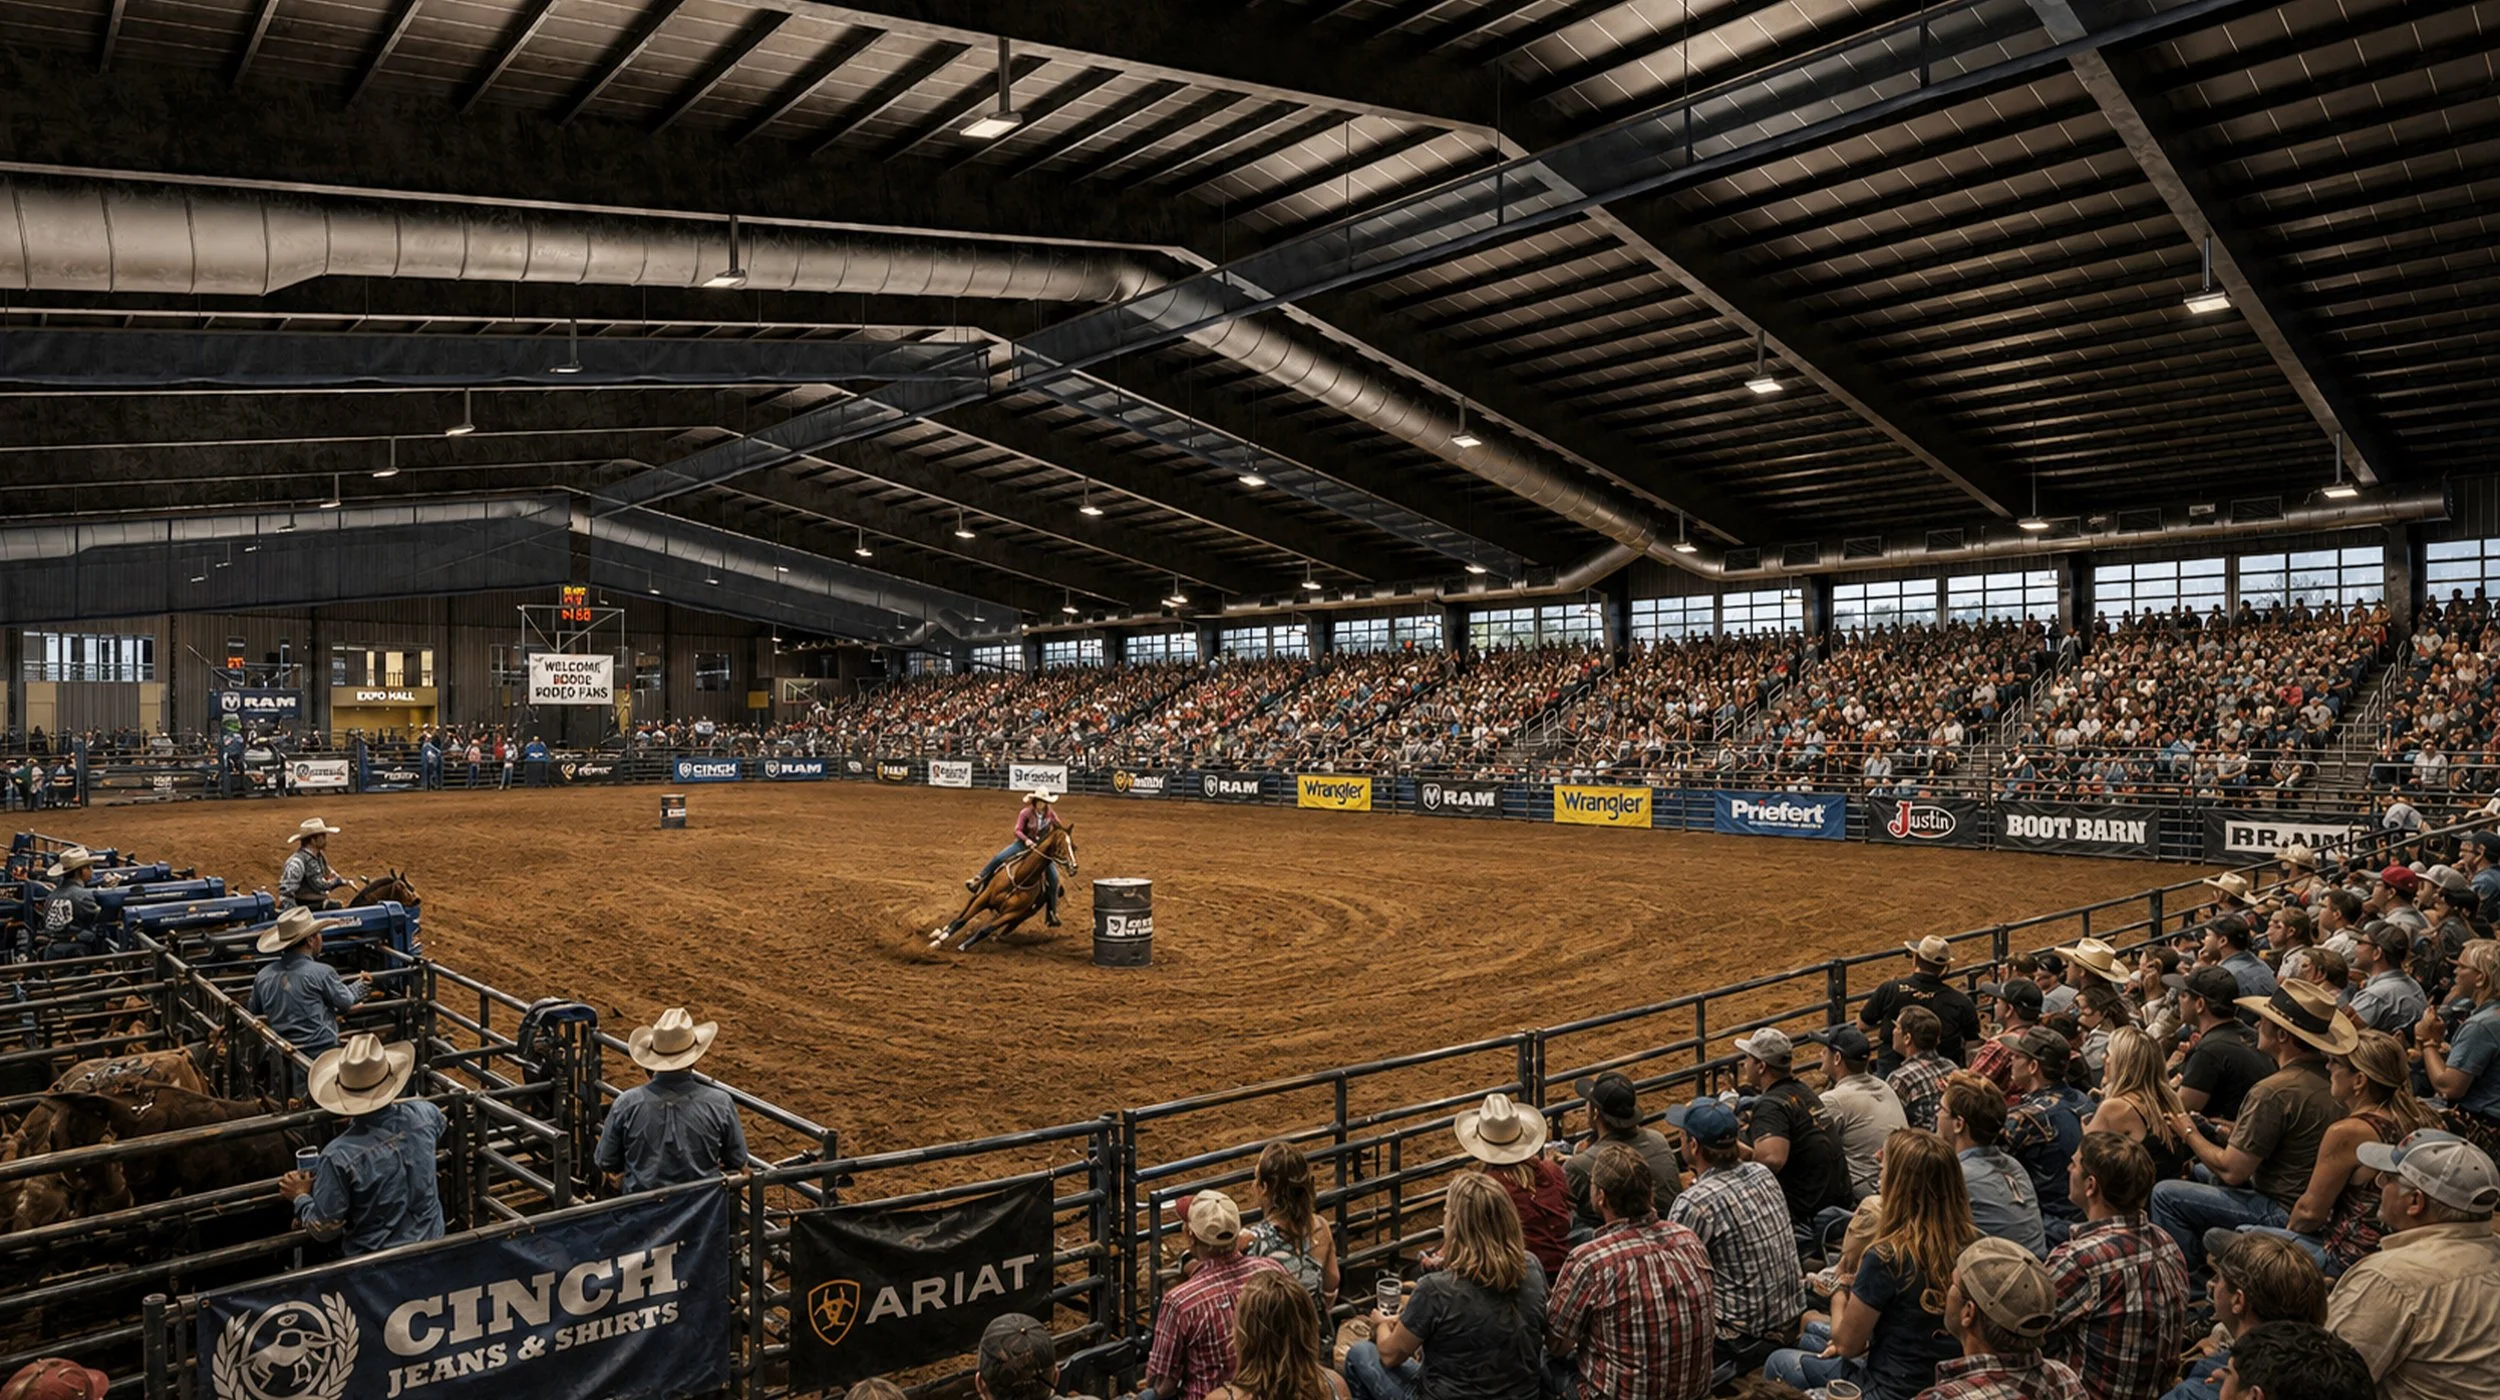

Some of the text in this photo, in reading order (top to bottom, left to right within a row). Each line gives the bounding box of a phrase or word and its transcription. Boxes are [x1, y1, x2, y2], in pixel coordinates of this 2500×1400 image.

[244, 696, 296, 708] RAM
[781, 763, 822, 773] RAM
[1219, 780, 1259, 794] RAM
[1304, 780, 1365, 805] Wrangler
[1443, 789, 1495, 807] RAM
[1561, 791, 1644, 821] Wrangler
[1731, 799, 1826, 823] Priefert
[1888, 801, 1950, 838] Justin
[2006, 814, 2147, 844] BOOT BARN
[384, 1241, 680, 1356] CINCH
[864, 1254, 1036, 1325] ARIAT
[387, 1301, 680, 1399] JEANS & SHIRTS
